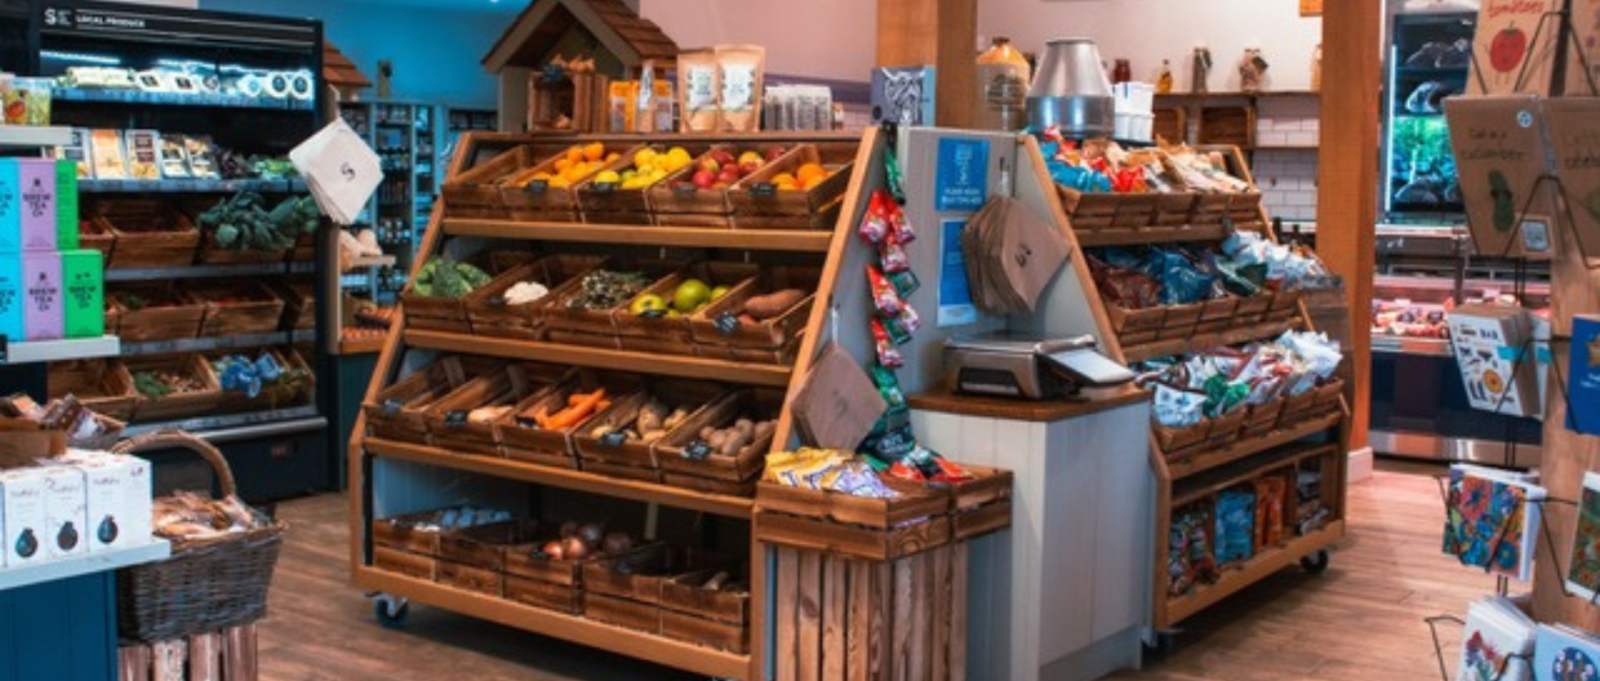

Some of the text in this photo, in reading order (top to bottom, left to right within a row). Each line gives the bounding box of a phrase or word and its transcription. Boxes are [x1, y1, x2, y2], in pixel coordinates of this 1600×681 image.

[23, 193, 51, 201] BREW
[29, 201, 46, 209] TEA
[29, 287, 57, 295] BREW
